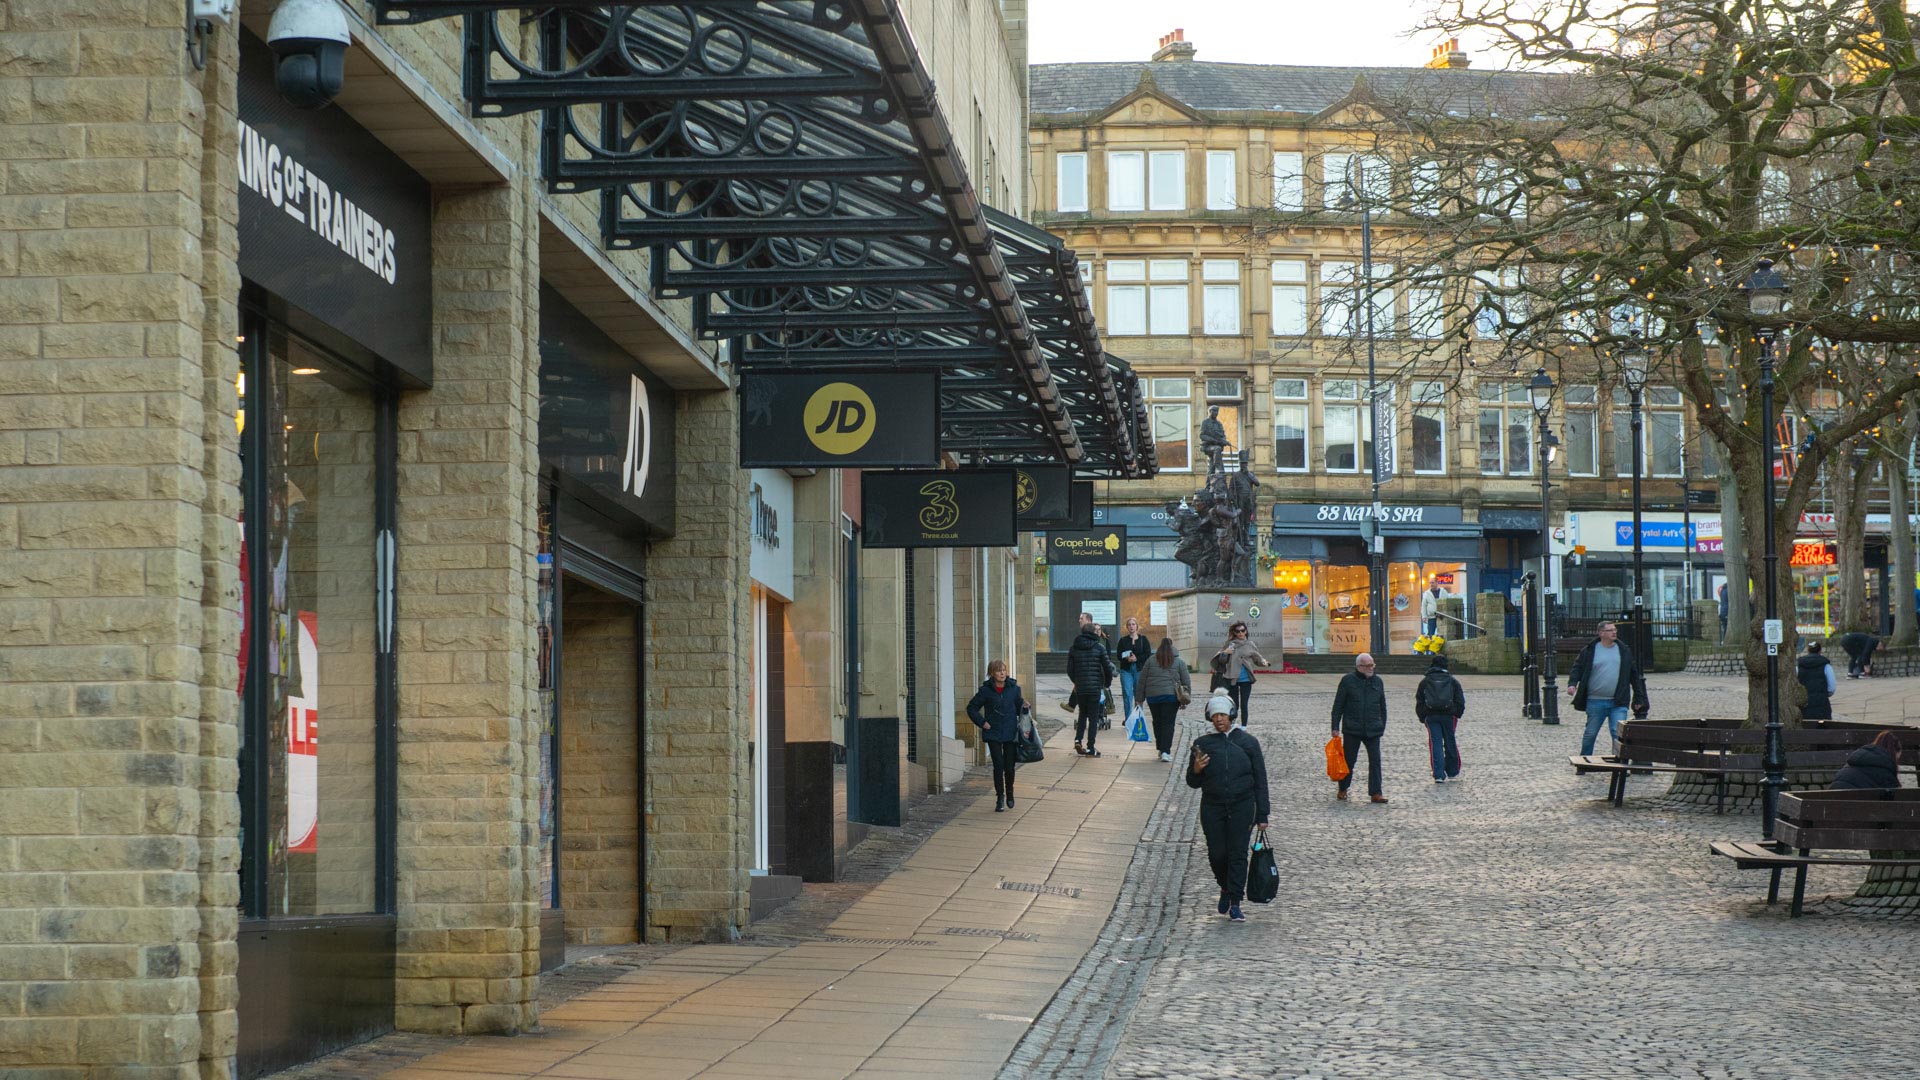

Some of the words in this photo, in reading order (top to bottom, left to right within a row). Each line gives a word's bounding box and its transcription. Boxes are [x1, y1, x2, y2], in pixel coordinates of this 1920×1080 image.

[238, 120, 283, 207] KING
[284, 155, 304, 204] OF
[305, 169, 396, 285] TRAINERS
[815, 400, 866, 434] JD
[623, 373, 651, 498] JD
[1150, 512, 1173, 520] GOL
[1316, 505, 1340, 521] 88
[1342, 506, 1390, 522] NAIS
[1392, 507, 1424, 522] SPA
[1697, 519, 1722, 530] braml
[1640, 529, 1661, 538] ystal
[1054, 537, 1083, 550] Grape
[1083, 537, 1103, 547] Tree
[1698, 542, 1708, 552] To
[1794, 544, 1825, 554] SOFT
[1635, 596, 1641, 604] 4
[1770, 644, 1777, 654] 5
[288, 706, 318, 757] LE
